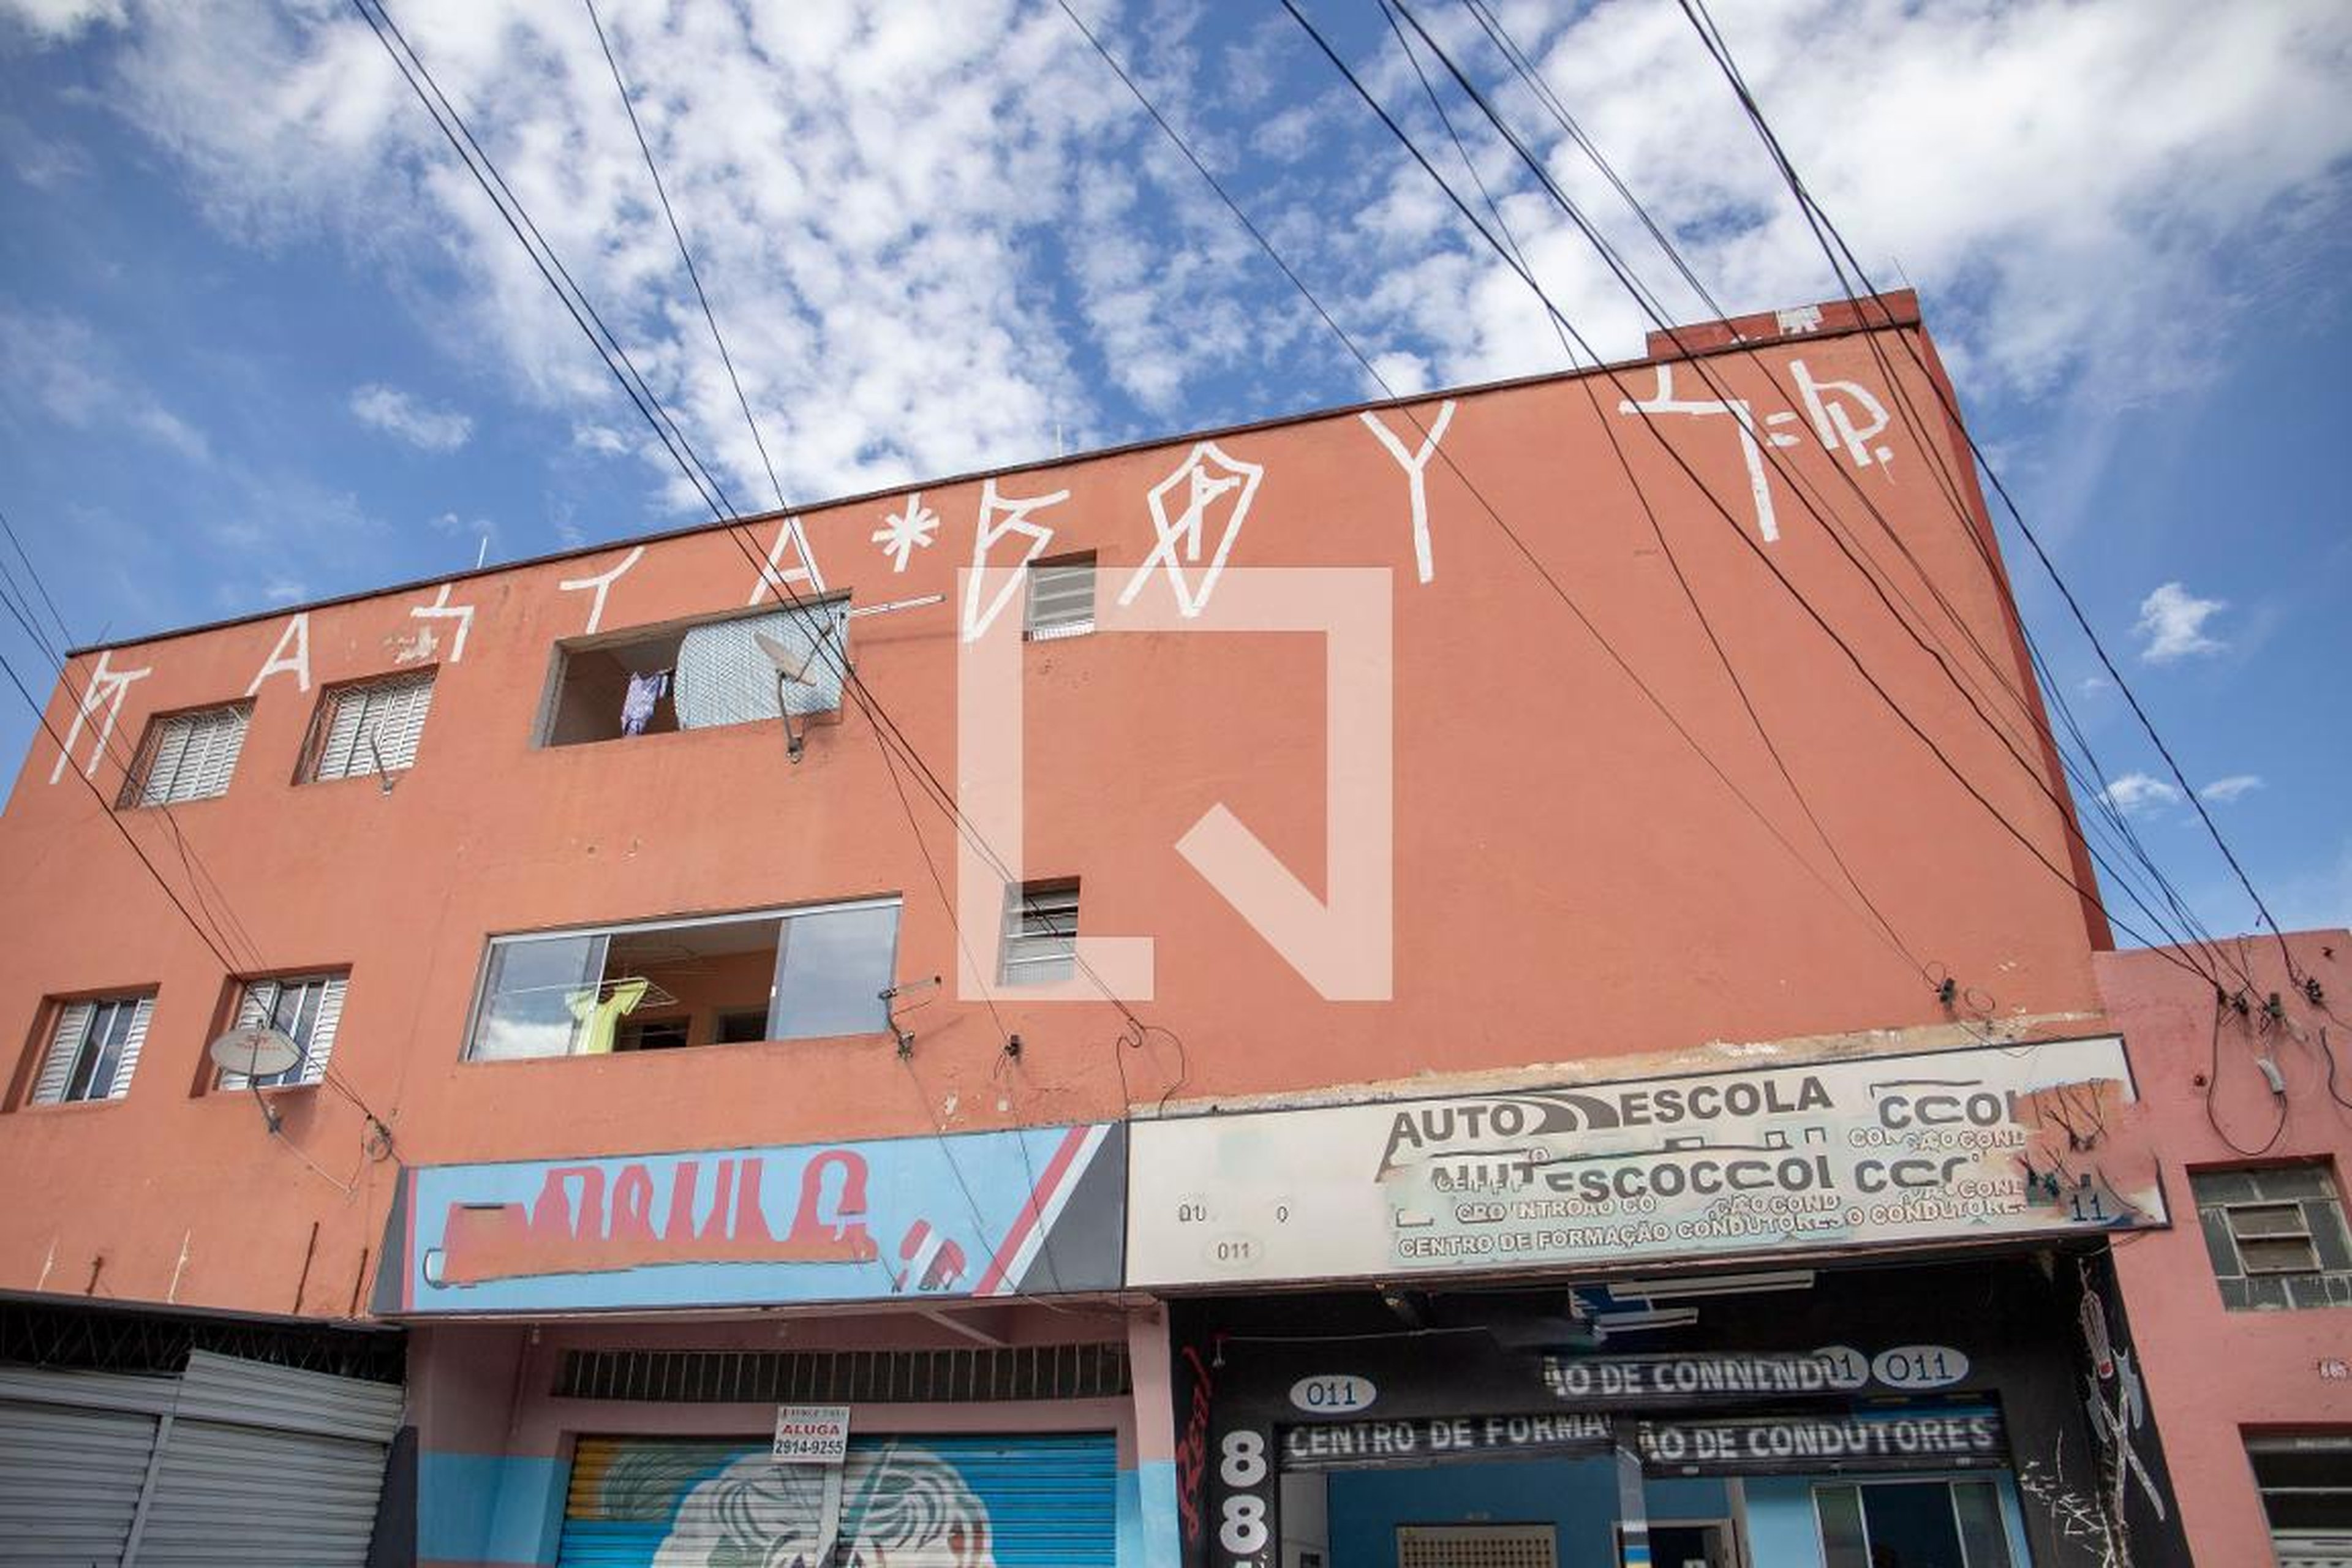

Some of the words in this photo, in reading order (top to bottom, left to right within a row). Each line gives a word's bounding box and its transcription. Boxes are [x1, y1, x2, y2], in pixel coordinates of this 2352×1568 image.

[1374, 1102, 1525, 1182] AUTO
[1620, 1076, 1833, 1128] ESCOLA
[1218, 1242, 1249, 1261] 011
[1399, 1235, 1494, 1258] CENTRO
[1499, 1232, 1532, 1253] DE
[1538, 1221, 1672, 1250] FORMAÇÃO
[1886, 1352, 1954, 1381] 011
[1306, 1382, 1357, 1408] 011
[783, 1424, 840, 1435] ALUGA
[1289, 1420, 1415, 1457] CENTRO
[1430, 1419, 1473, 1450] DE
[1697, 1428, 1737, 1460] DE
[1748, 1419, 1994, 1458] CONDUTORES
